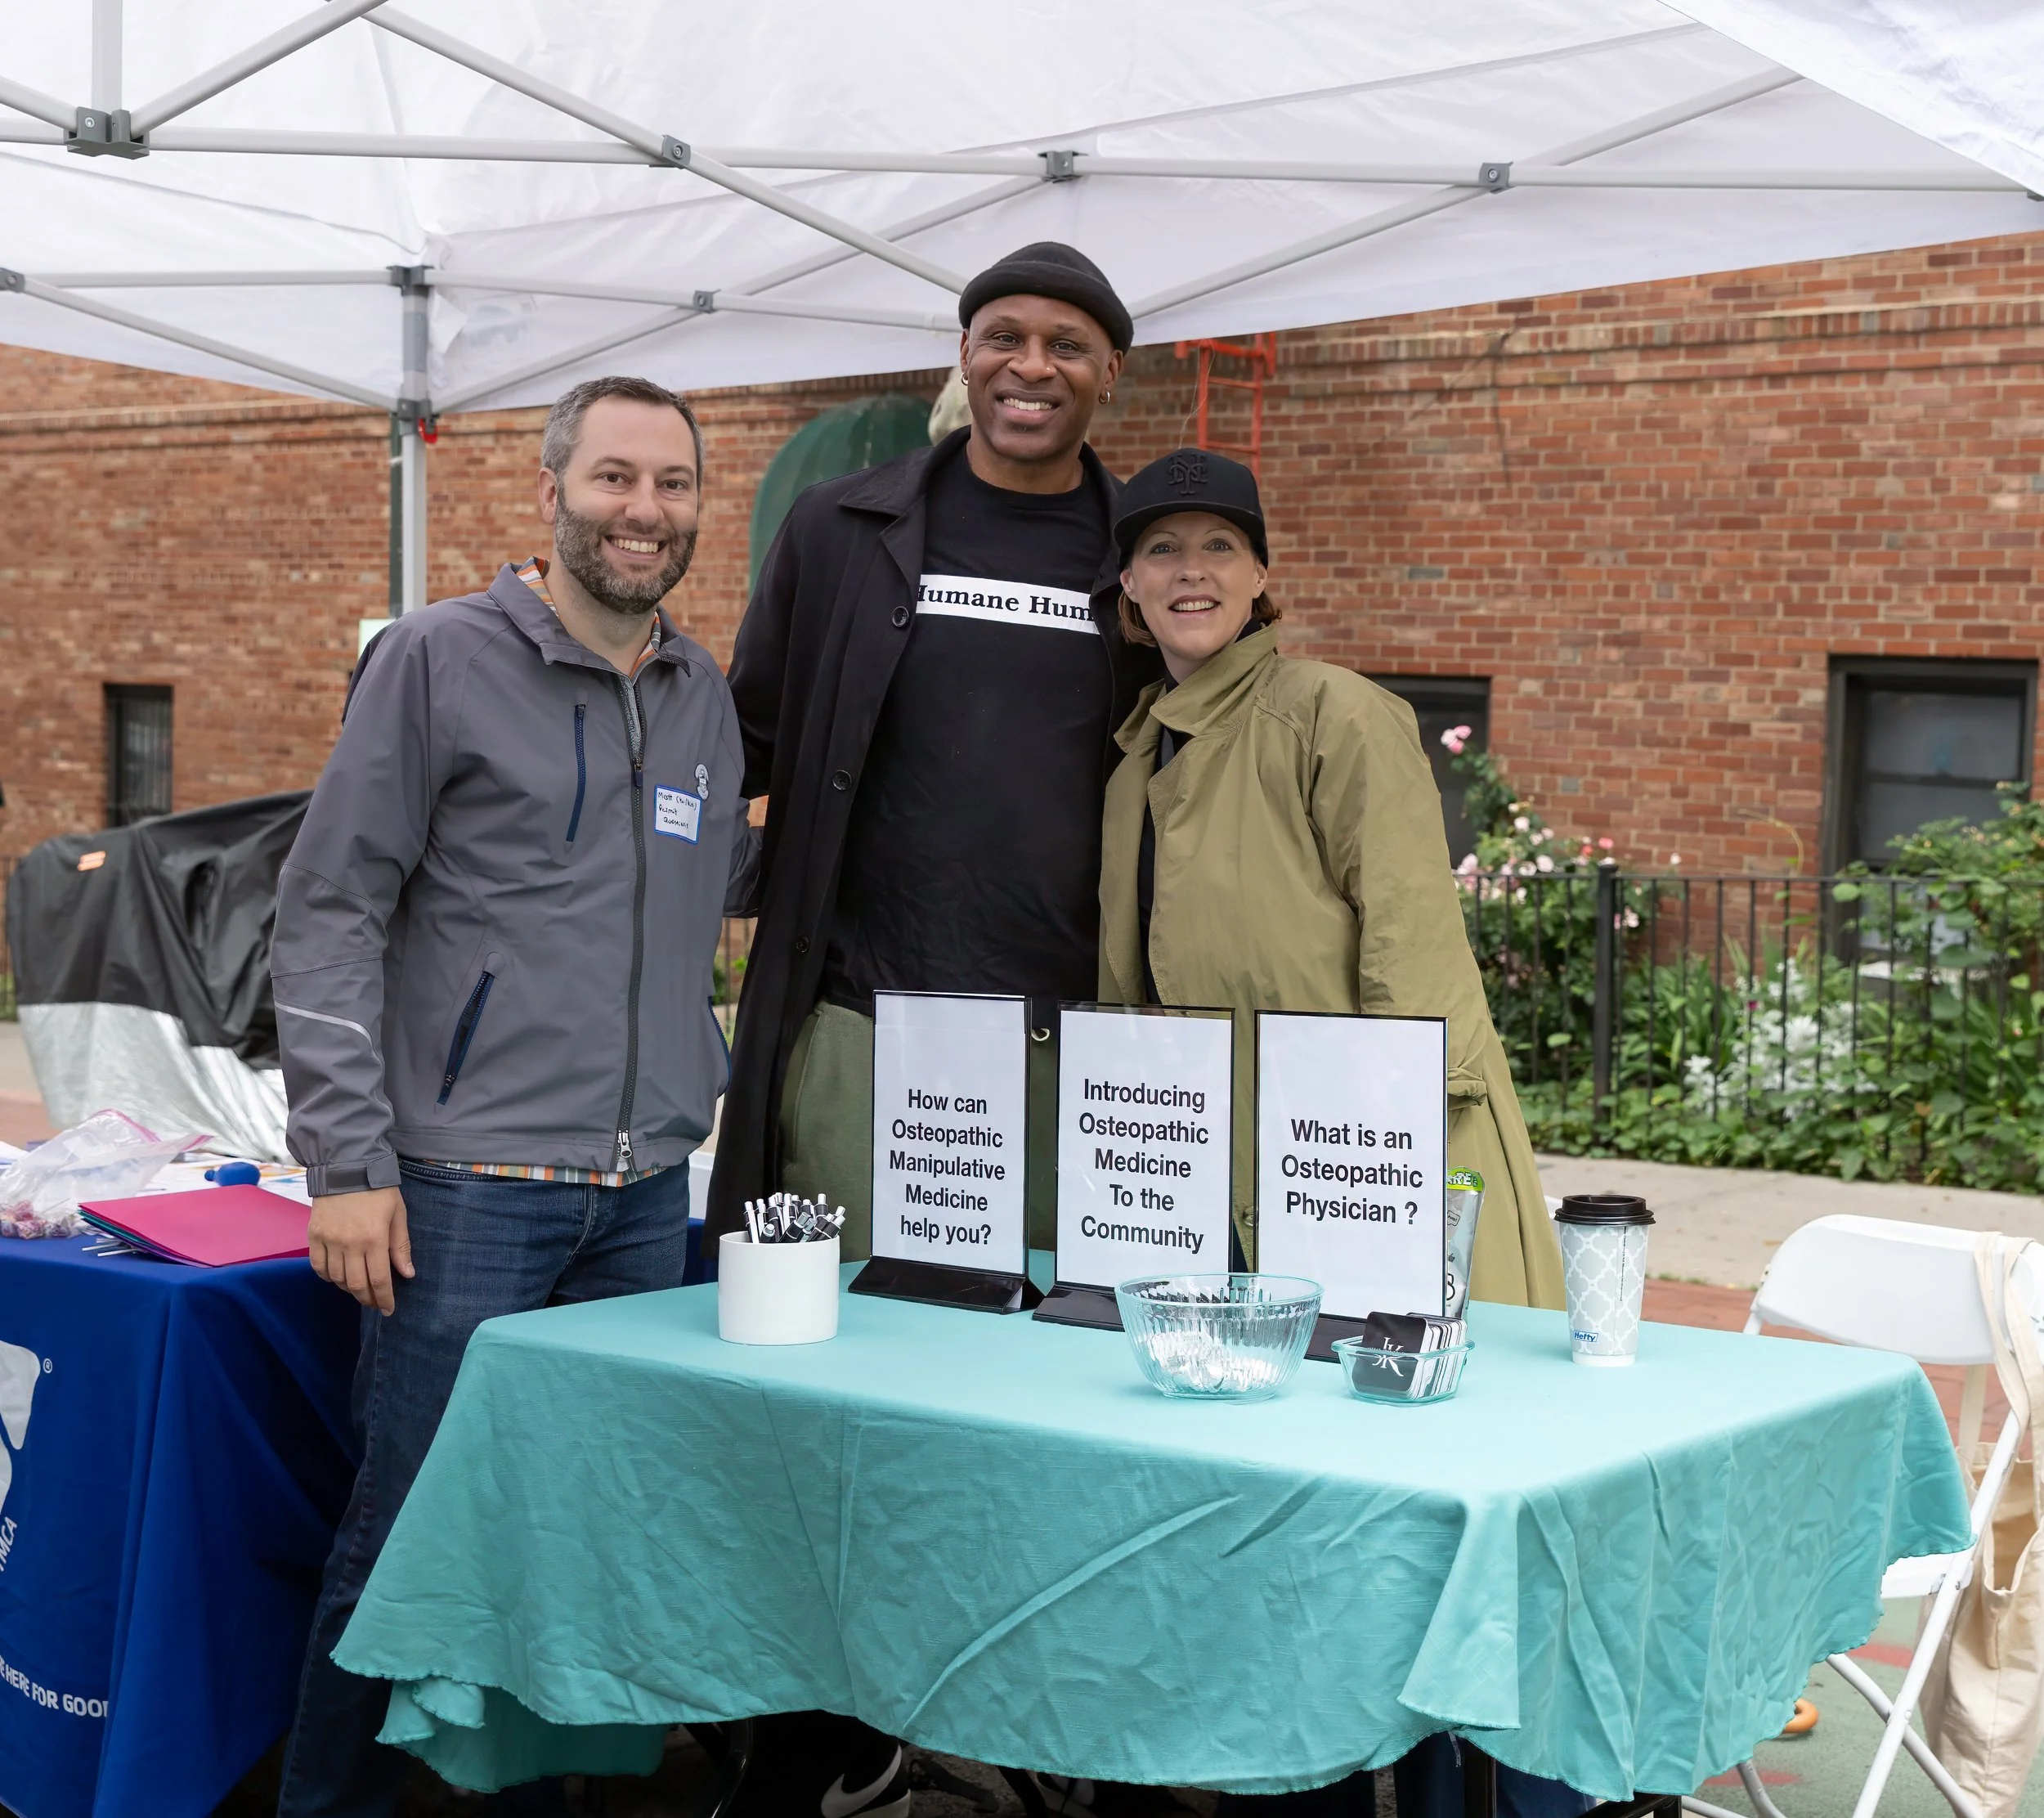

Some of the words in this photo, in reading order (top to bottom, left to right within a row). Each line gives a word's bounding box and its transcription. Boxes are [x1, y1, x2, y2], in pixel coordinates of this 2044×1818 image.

[917, 585, 1020, 612] Humane
[908, 1089, 949, 1111] How
[954, 1097, 987, 1114] can
[1084, 1078, 1205, 1114] Introducing
[892, 1119, 1003, 1147] Osteopathic
[1079, 1112, 1208, 1144] Osteopathic
[1290, 1118, 1351, 1146] What
[1358, 1124, 1376, 1147] is
[1383, 1130, 1412, 1150] an
[890, 1150, 1006, 1180] Manipulative
[1095, 1147, 1192, 1178] Medicine
[1281, 1154, 1423, 1188] Osteopathic
[905, 1183, 988, 1211] Medicine
[1109, 1183, 1133, 1207] To
[1140, 1188, 1175, 1211] the
[1286, 1191, 1396, 1223] Physician
[1405, 1201, 1418, 1225] ?
[900, 1214, 940, 1243] help
[945, 1223, 992, 1245] you?
[1081, 1215, 1204, 1255] Community
[1574, 1331, 1596, 1342] Hefty
[0, 1516, 17, 1571] MCA
[5, 1663, 30, 1698] HERE
[32, 1681, 60, 1710] FOR
